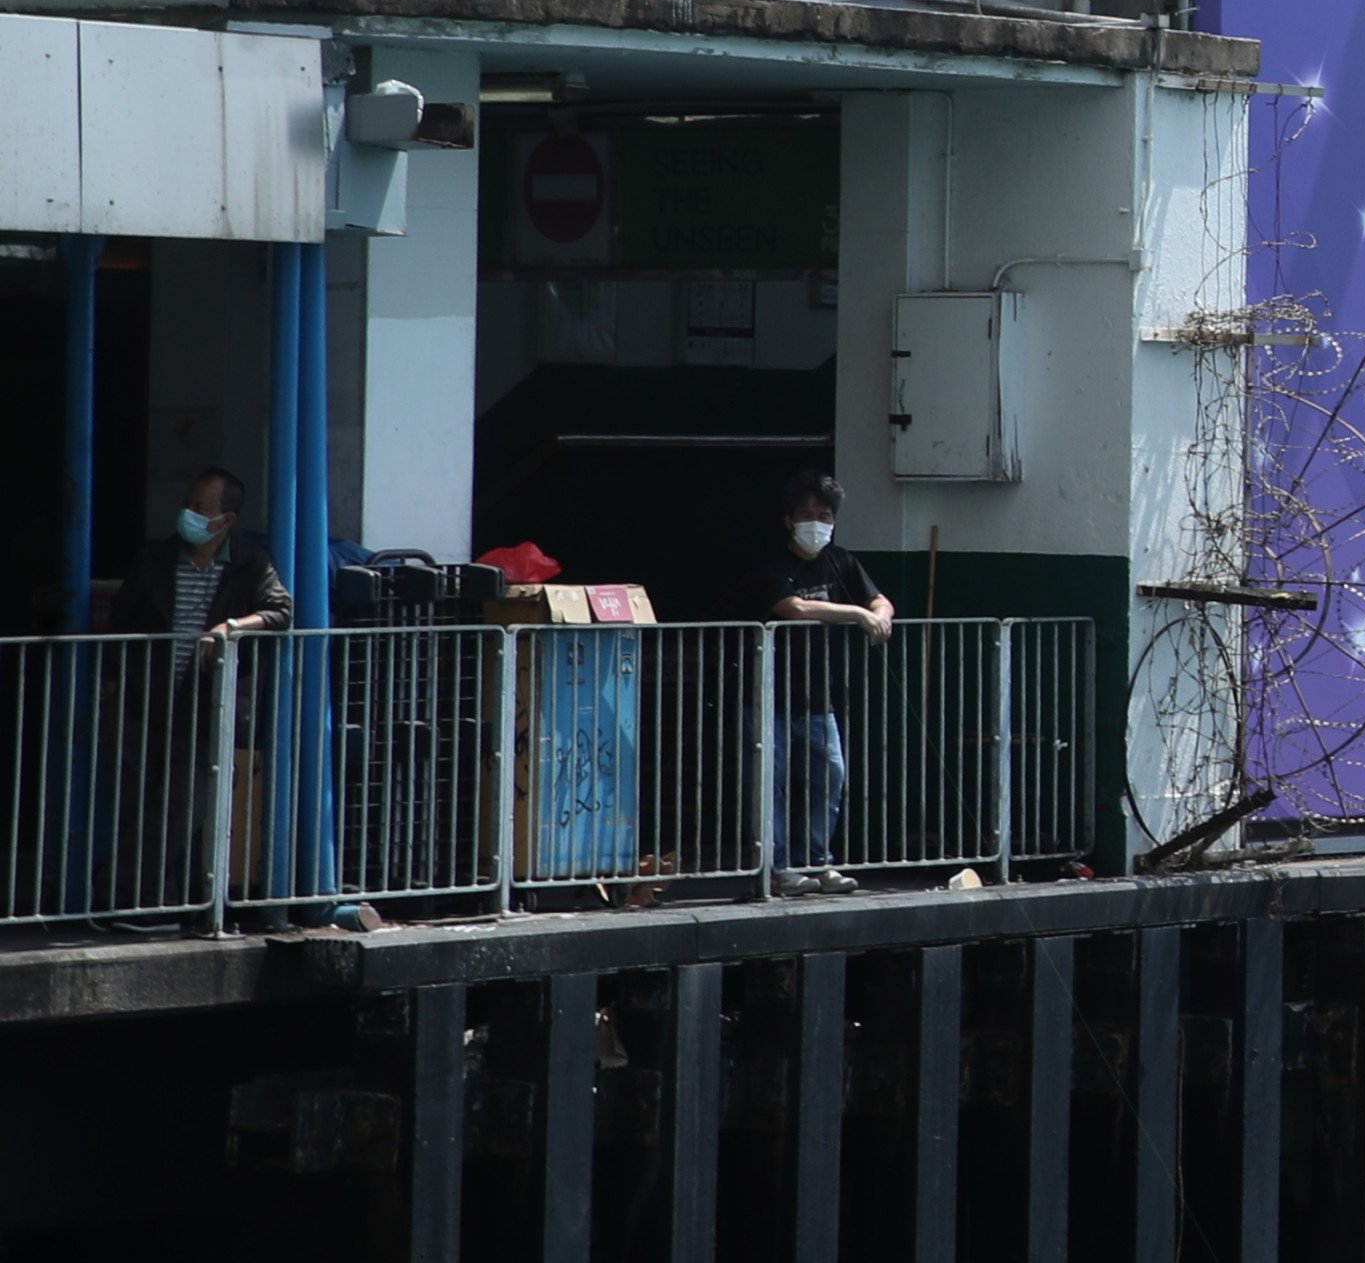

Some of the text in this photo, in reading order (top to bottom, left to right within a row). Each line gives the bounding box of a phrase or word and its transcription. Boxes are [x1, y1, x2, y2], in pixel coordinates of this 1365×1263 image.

[653, 146, 764, 178] SEEING
[653, 184, 714, 215] THE
[650, 223, 778, 254] UNSEEN
